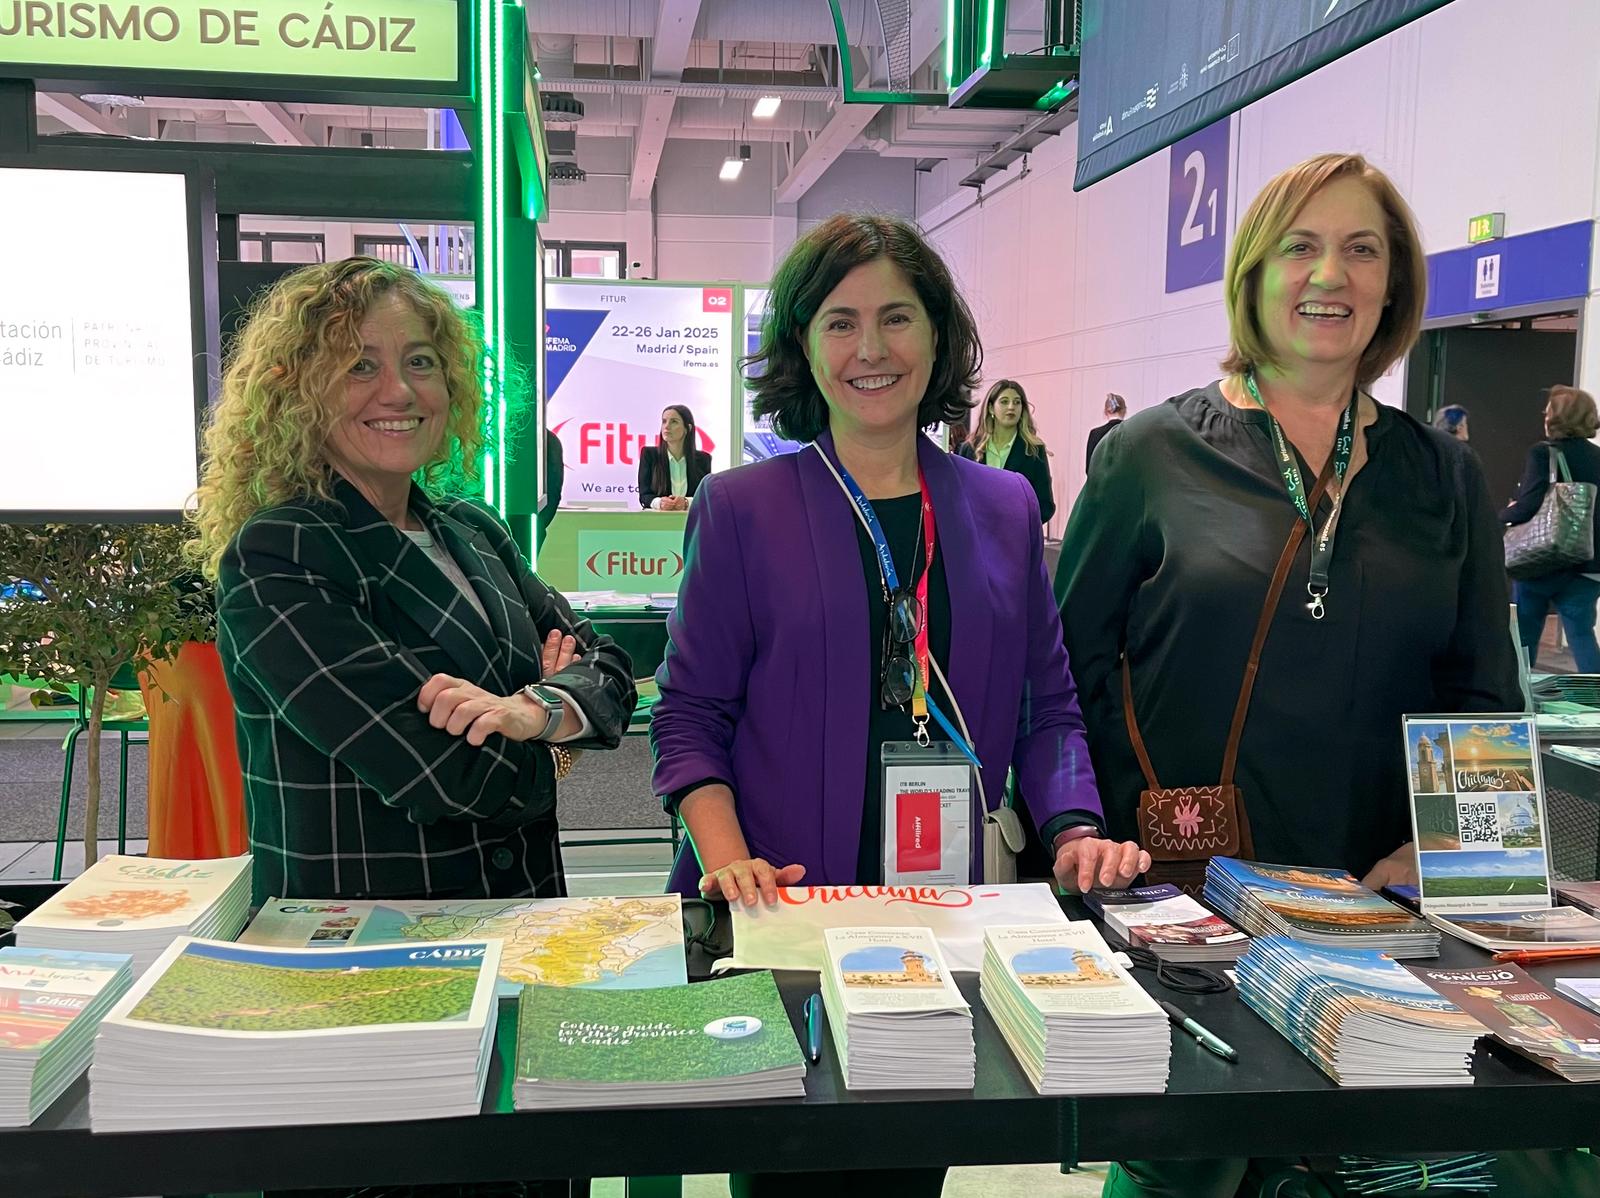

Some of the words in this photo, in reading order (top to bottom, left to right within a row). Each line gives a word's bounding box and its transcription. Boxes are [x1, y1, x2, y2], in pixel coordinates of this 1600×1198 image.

[199, 8, 260, 46] DE
[278, 1, 417, 53] CÁDIZ
[600, 294, 627, 303] FITUR
[708, 296, 728, 306] 02
[611, 325, 652, 338] 22-26
[656, 327, 681, 339] Jan
[684, 328, 719, 339] 2025
[636, 344, 677, 355] Madrid
[686, 345, 719, 357] Spain
[0, 347, 44, 367] ádiz
[683, 360, 719, 369] ifema.es
[582, 482, 602, 493] We
[605, 485, 624, 493] are
[607, 551, 668, 576] Fitur
[588, 1029, 619, 1038] the
[626, 1022, 676, 1034] guide
[558, 1036, 575, 1046] of
